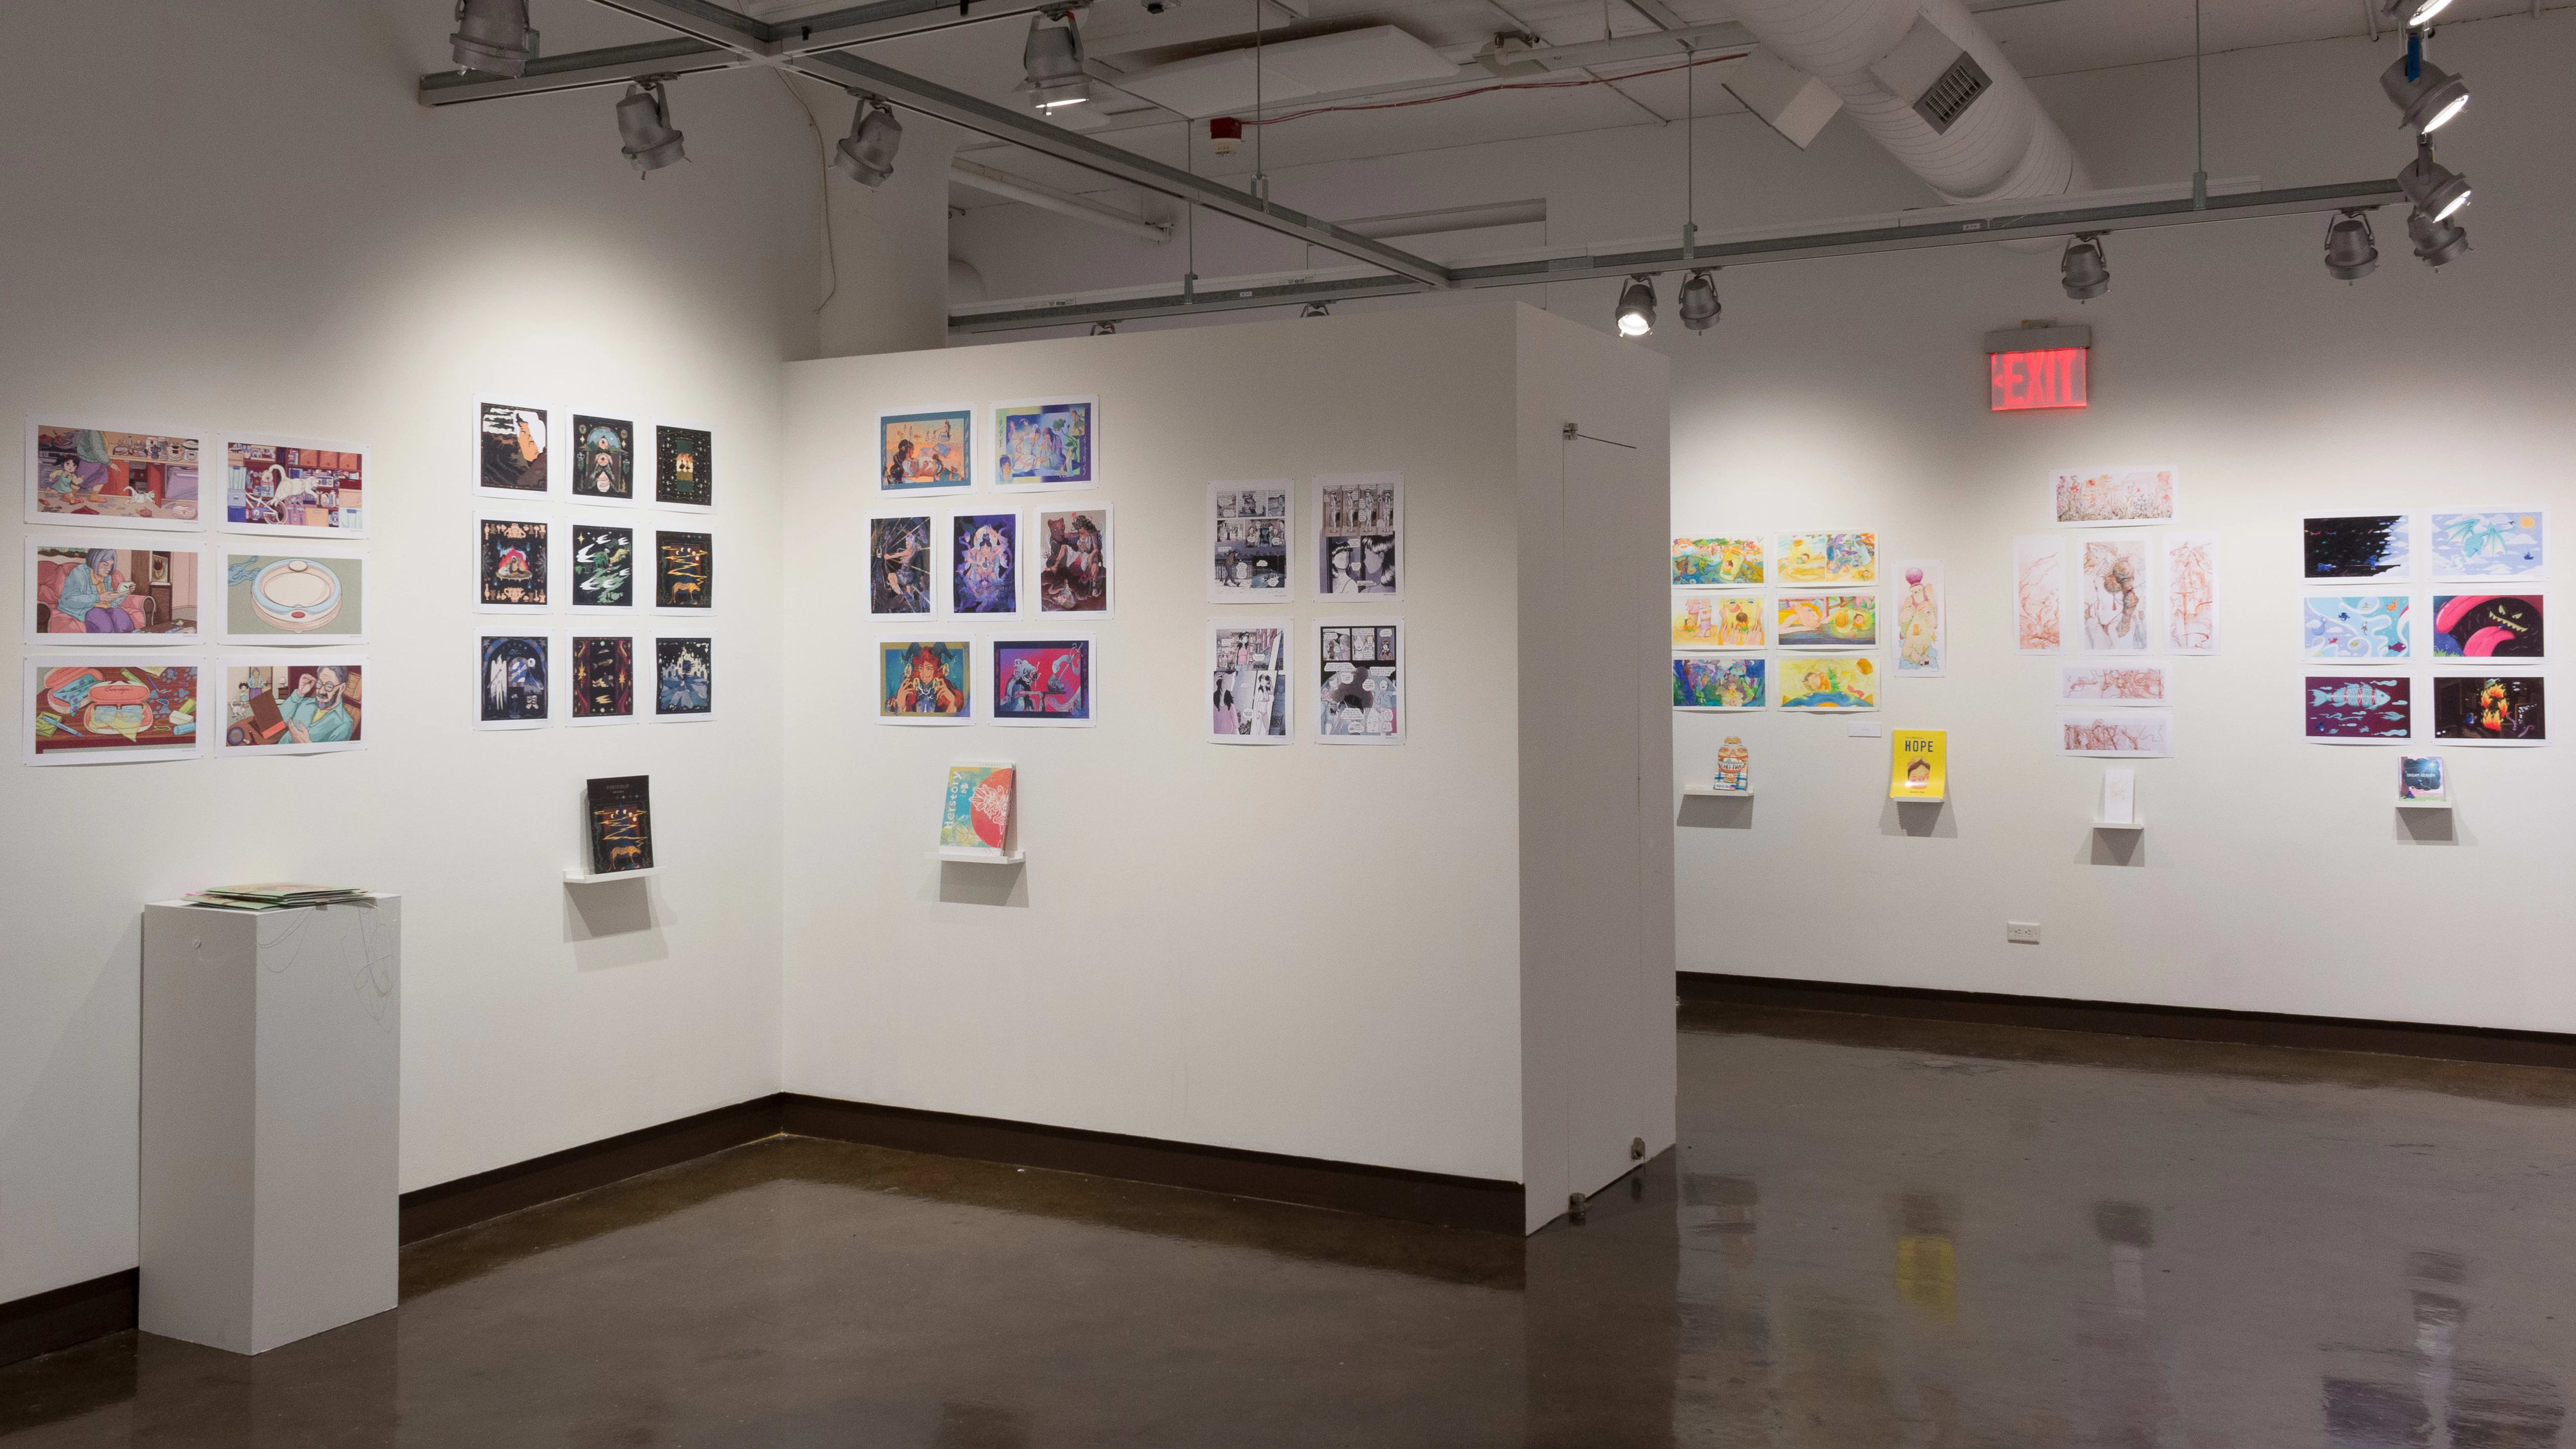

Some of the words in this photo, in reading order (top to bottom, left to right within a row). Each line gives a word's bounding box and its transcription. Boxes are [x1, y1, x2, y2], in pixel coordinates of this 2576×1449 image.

[2003, 351, 2077, 406] EXIT
[1905, 740, 1934, 752] HOPE
[944, 771, 962, 829] Herstory
